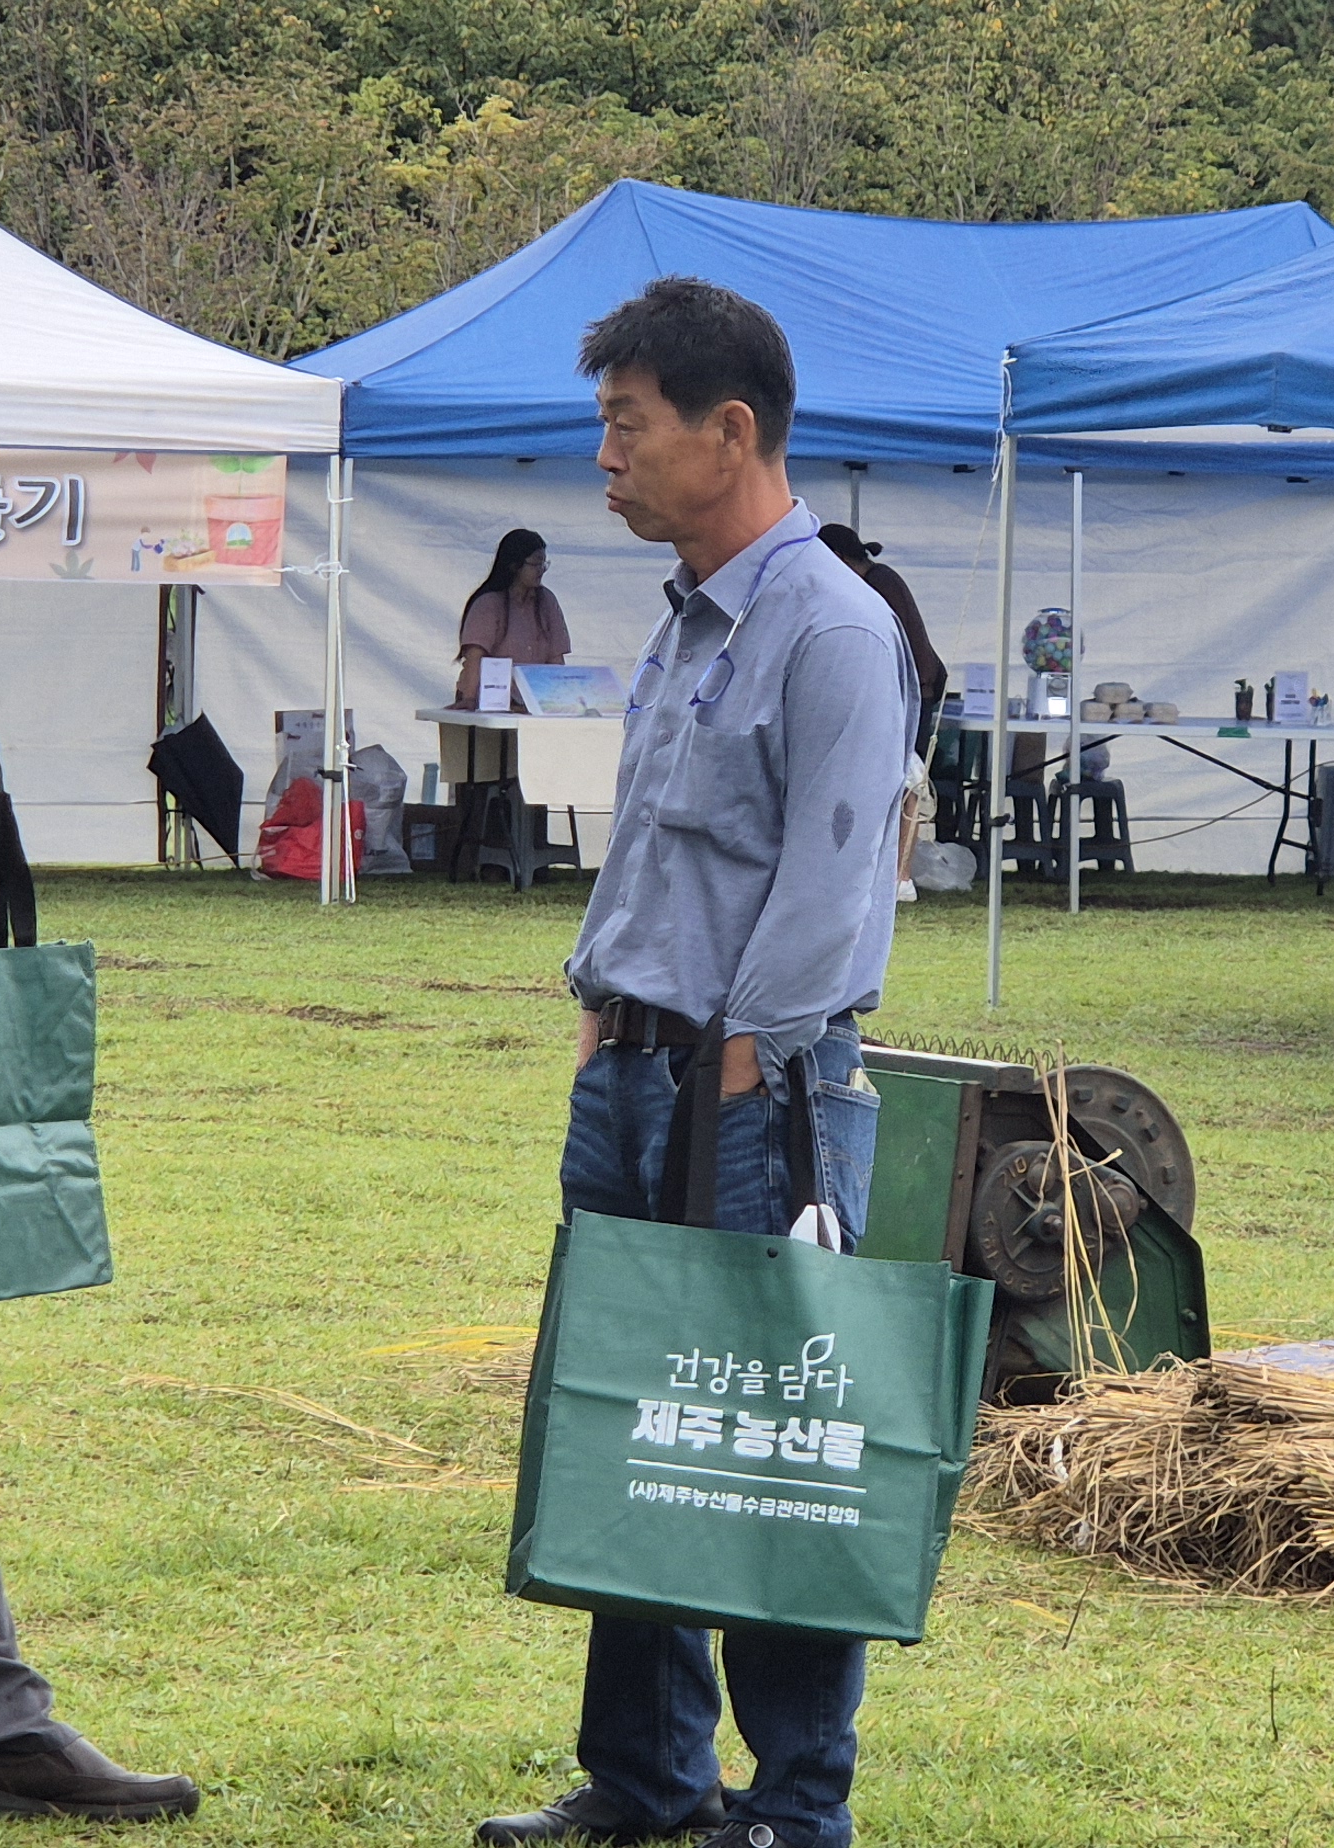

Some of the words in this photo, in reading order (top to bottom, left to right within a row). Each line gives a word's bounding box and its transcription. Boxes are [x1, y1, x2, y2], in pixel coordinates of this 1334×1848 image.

[667, 1348, 771, 1396] 건강을
[778, 1334, 854, 1408] 담다
[631, 1398, 724, 1451] 제주
[733, 1411, 865, 1470] 농산물
